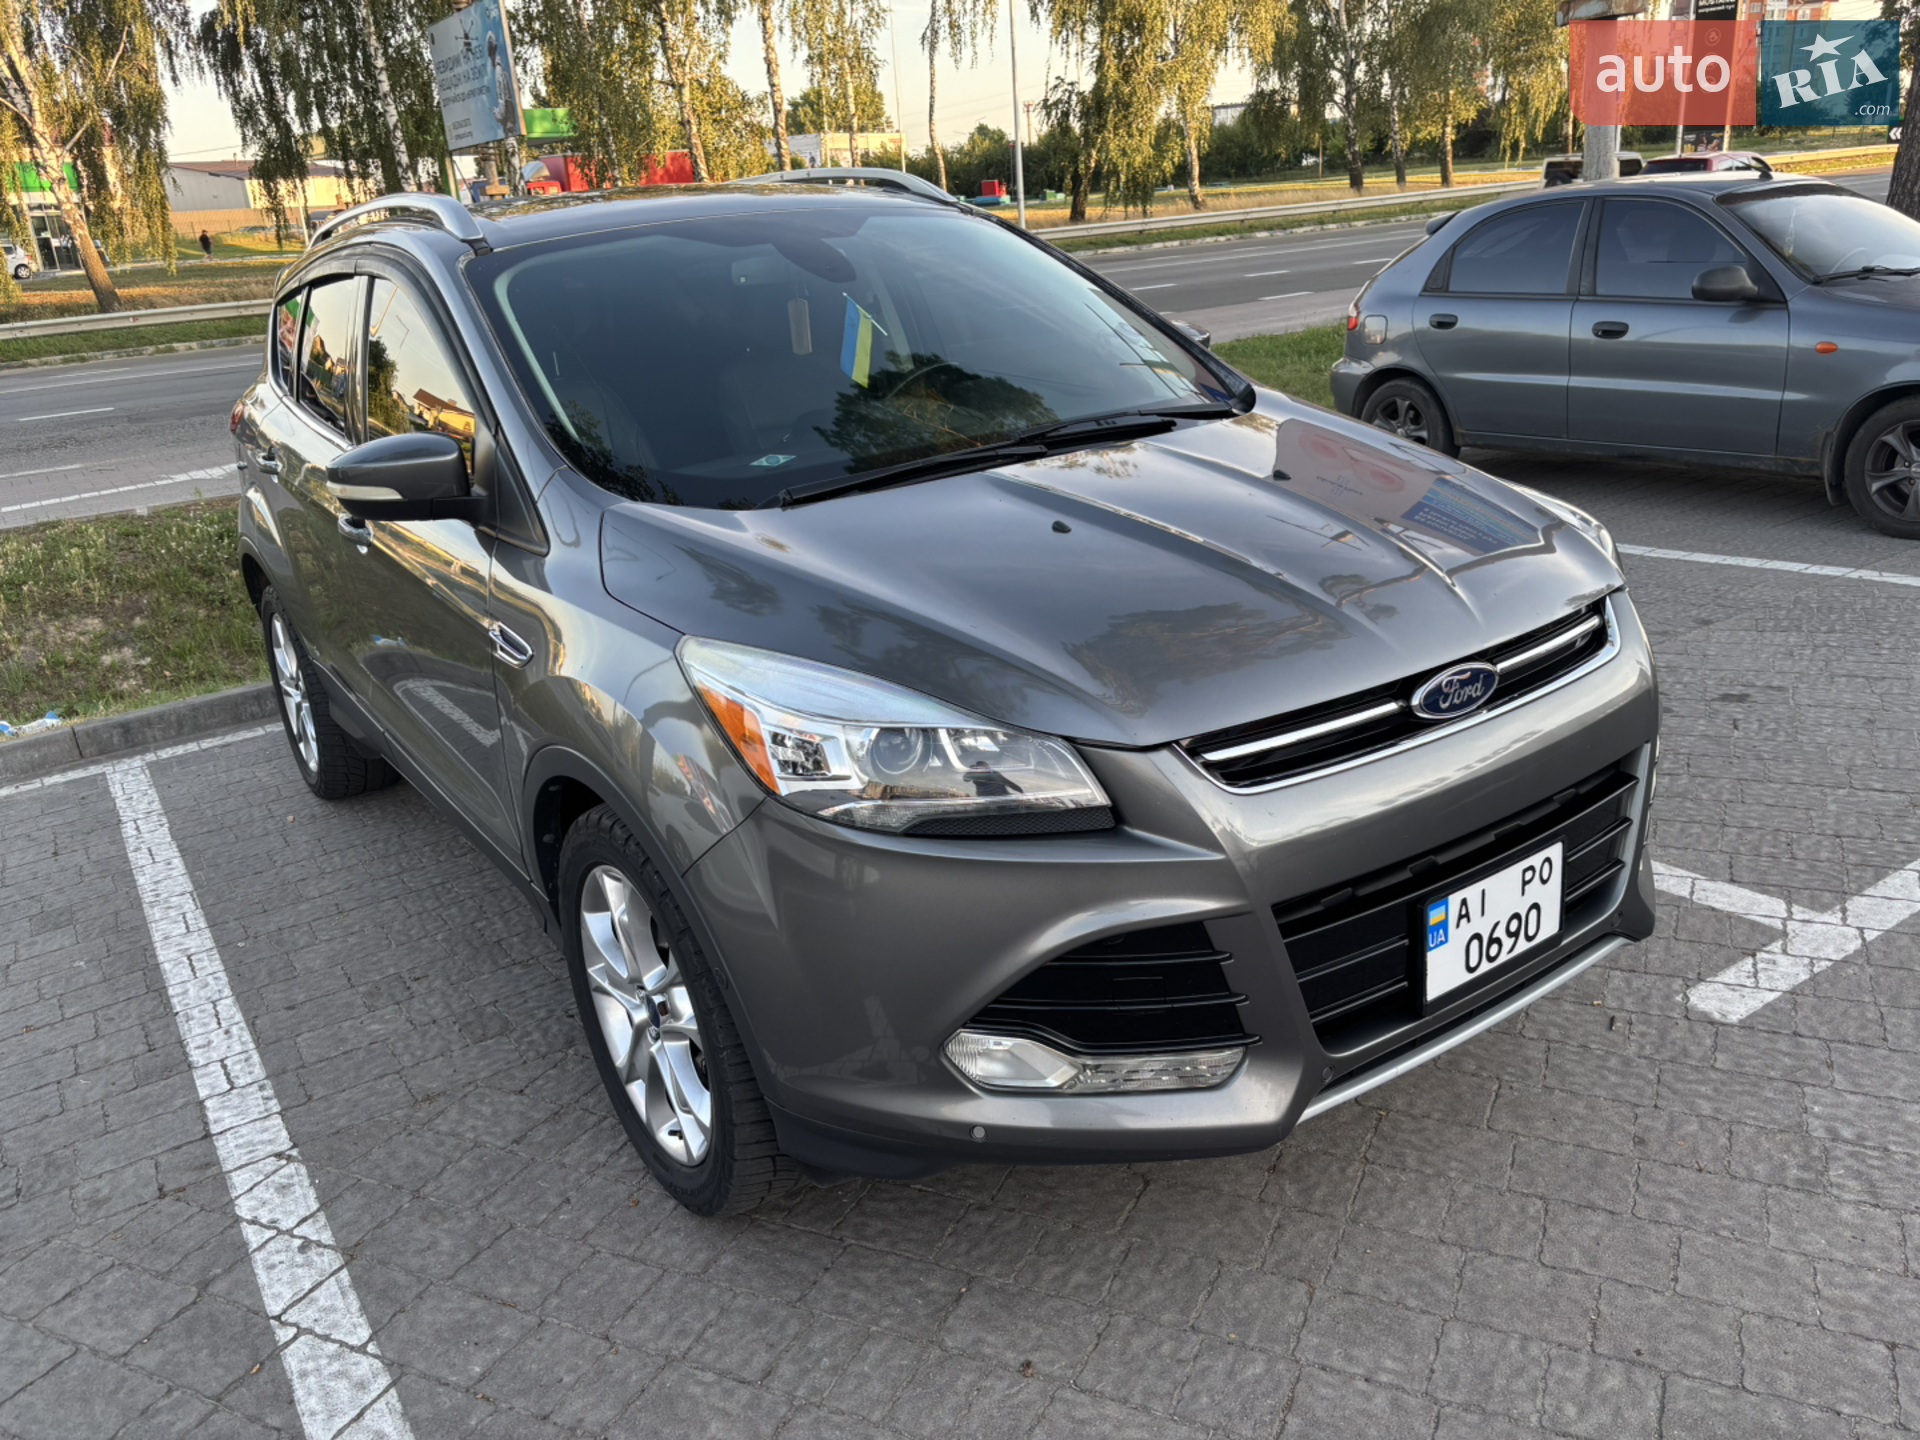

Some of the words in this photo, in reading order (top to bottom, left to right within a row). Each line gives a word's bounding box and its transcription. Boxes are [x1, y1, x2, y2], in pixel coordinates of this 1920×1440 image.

[1438, 671, 1488, 710] Ford
[1456, 888, 1486, 930] AI
[1521, 856, 1553, 897] PO
[1428, 929, 1446, 948] UA
[1465, 902, 1541, 974] 0690
